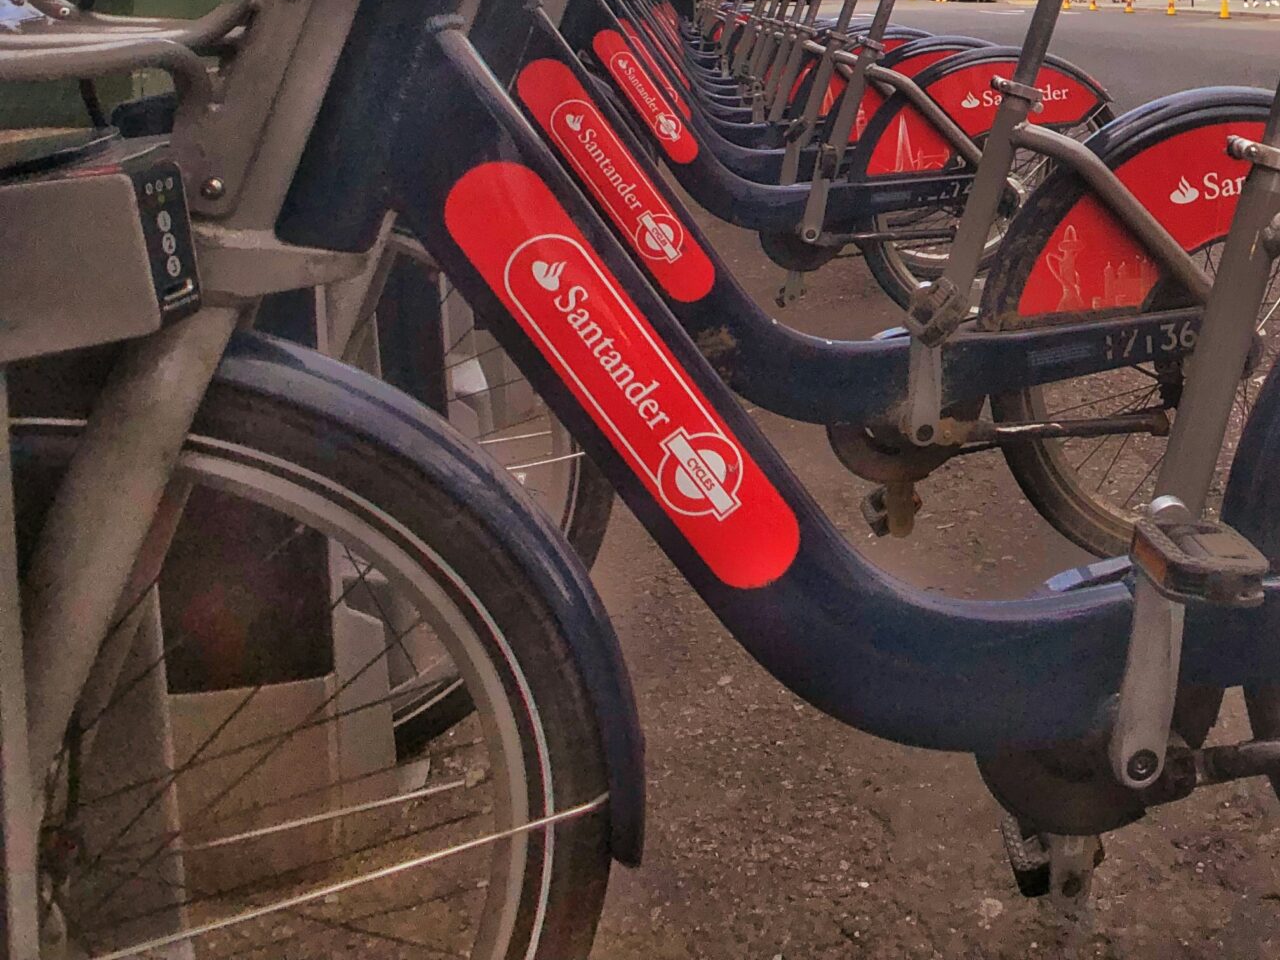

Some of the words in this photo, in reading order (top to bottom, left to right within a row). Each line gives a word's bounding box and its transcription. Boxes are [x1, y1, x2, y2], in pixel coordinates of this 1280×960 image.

[624, 67, 659, 113] Santander
[982, 83, 1069, 107] Sader
[578, 128, 642, 211] Santander
[651, 227, 668, 247] CYCLES
[554, 285, 670, 430] Santander
[686, 457, 716, 492] CYCLES
